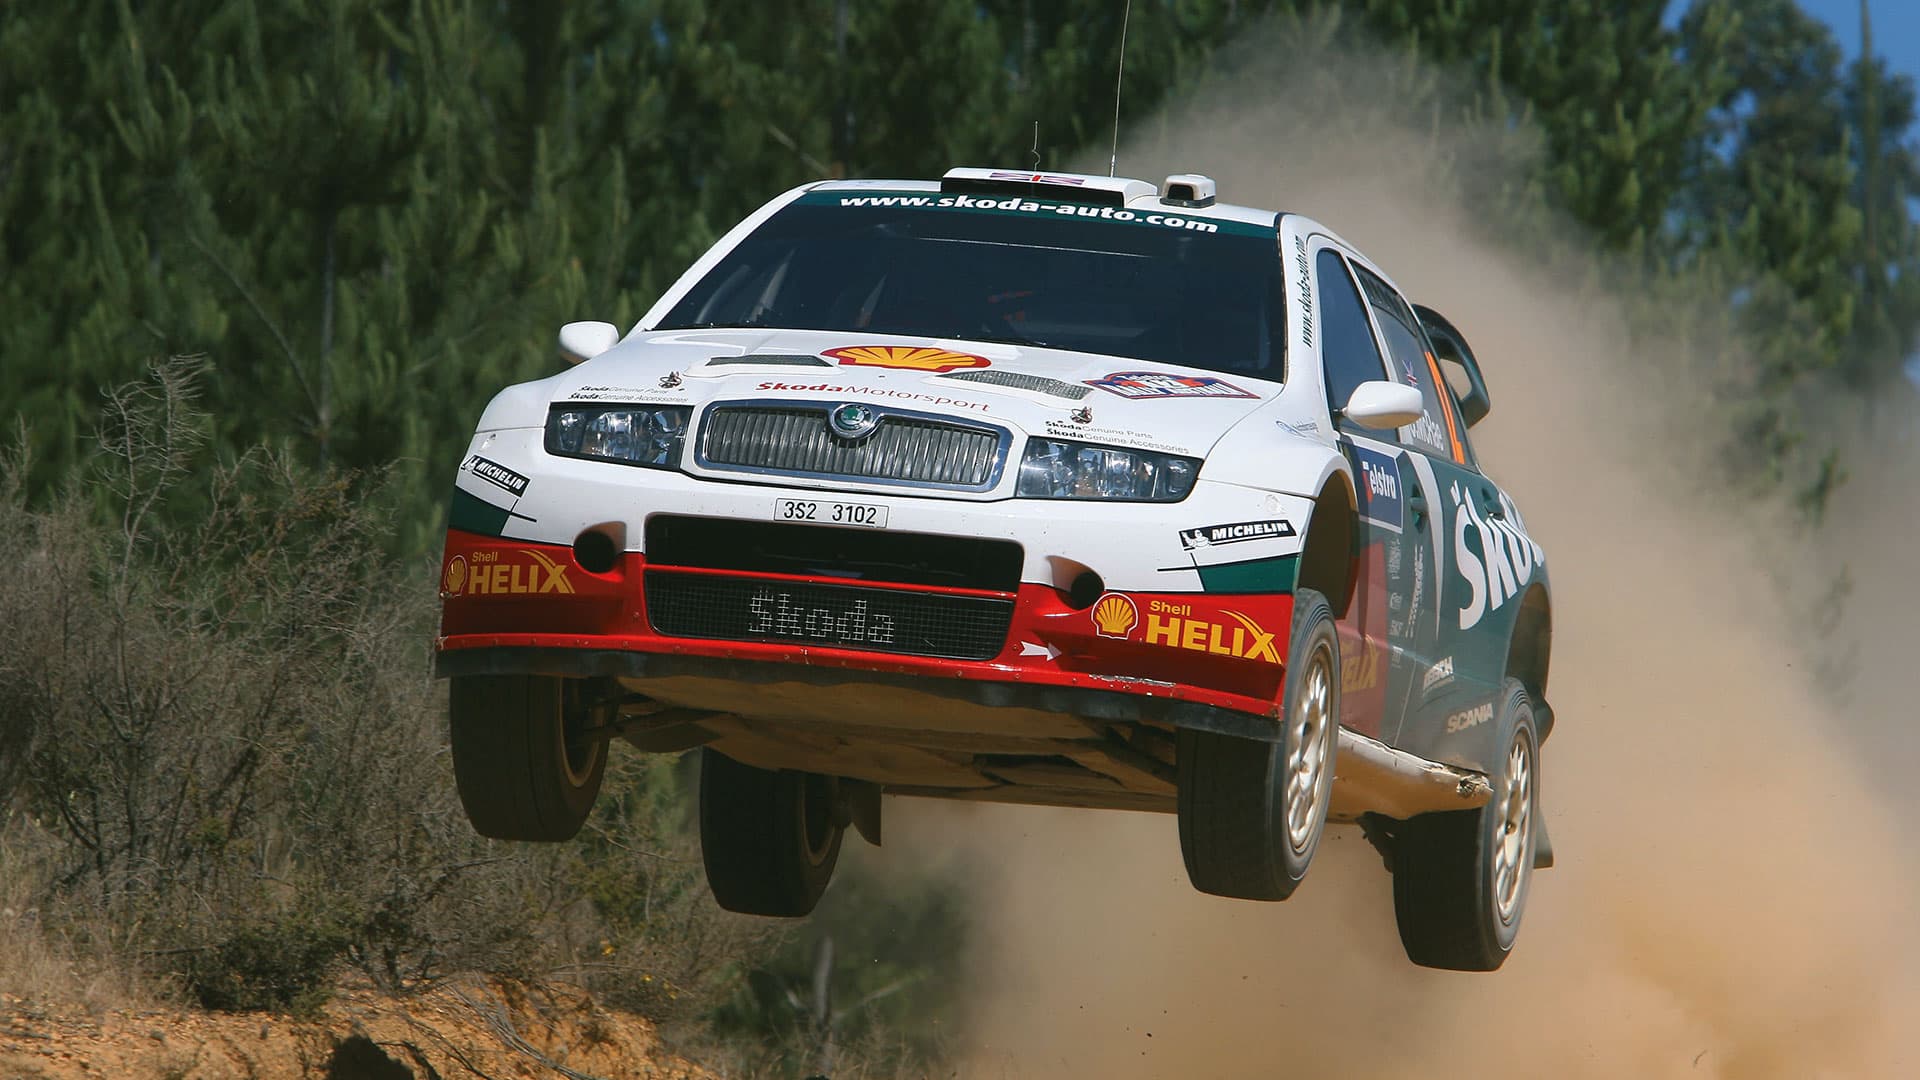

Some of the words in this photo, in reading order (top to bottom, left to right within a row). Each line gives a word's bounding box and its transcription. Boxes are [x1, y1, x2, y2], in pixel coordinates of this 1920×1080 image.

[839, 197, 1219, 233] www.skoda-auto.com
[475, 461, 526, 491] MICHELIN
[783, 501, 817, 520] 3S2
[831, 504, 878, 525] 3102
[1211, 522, 1289, 540] MICHELIN
[468, 550, 576, 595] HELIX
[471, 552, 498, 563] Shell
[1149, 600, 1191, 617] Shell
[1145, 609, 1283, 665] HELIX
[1447, 702, 1494, 734] SCANIA
